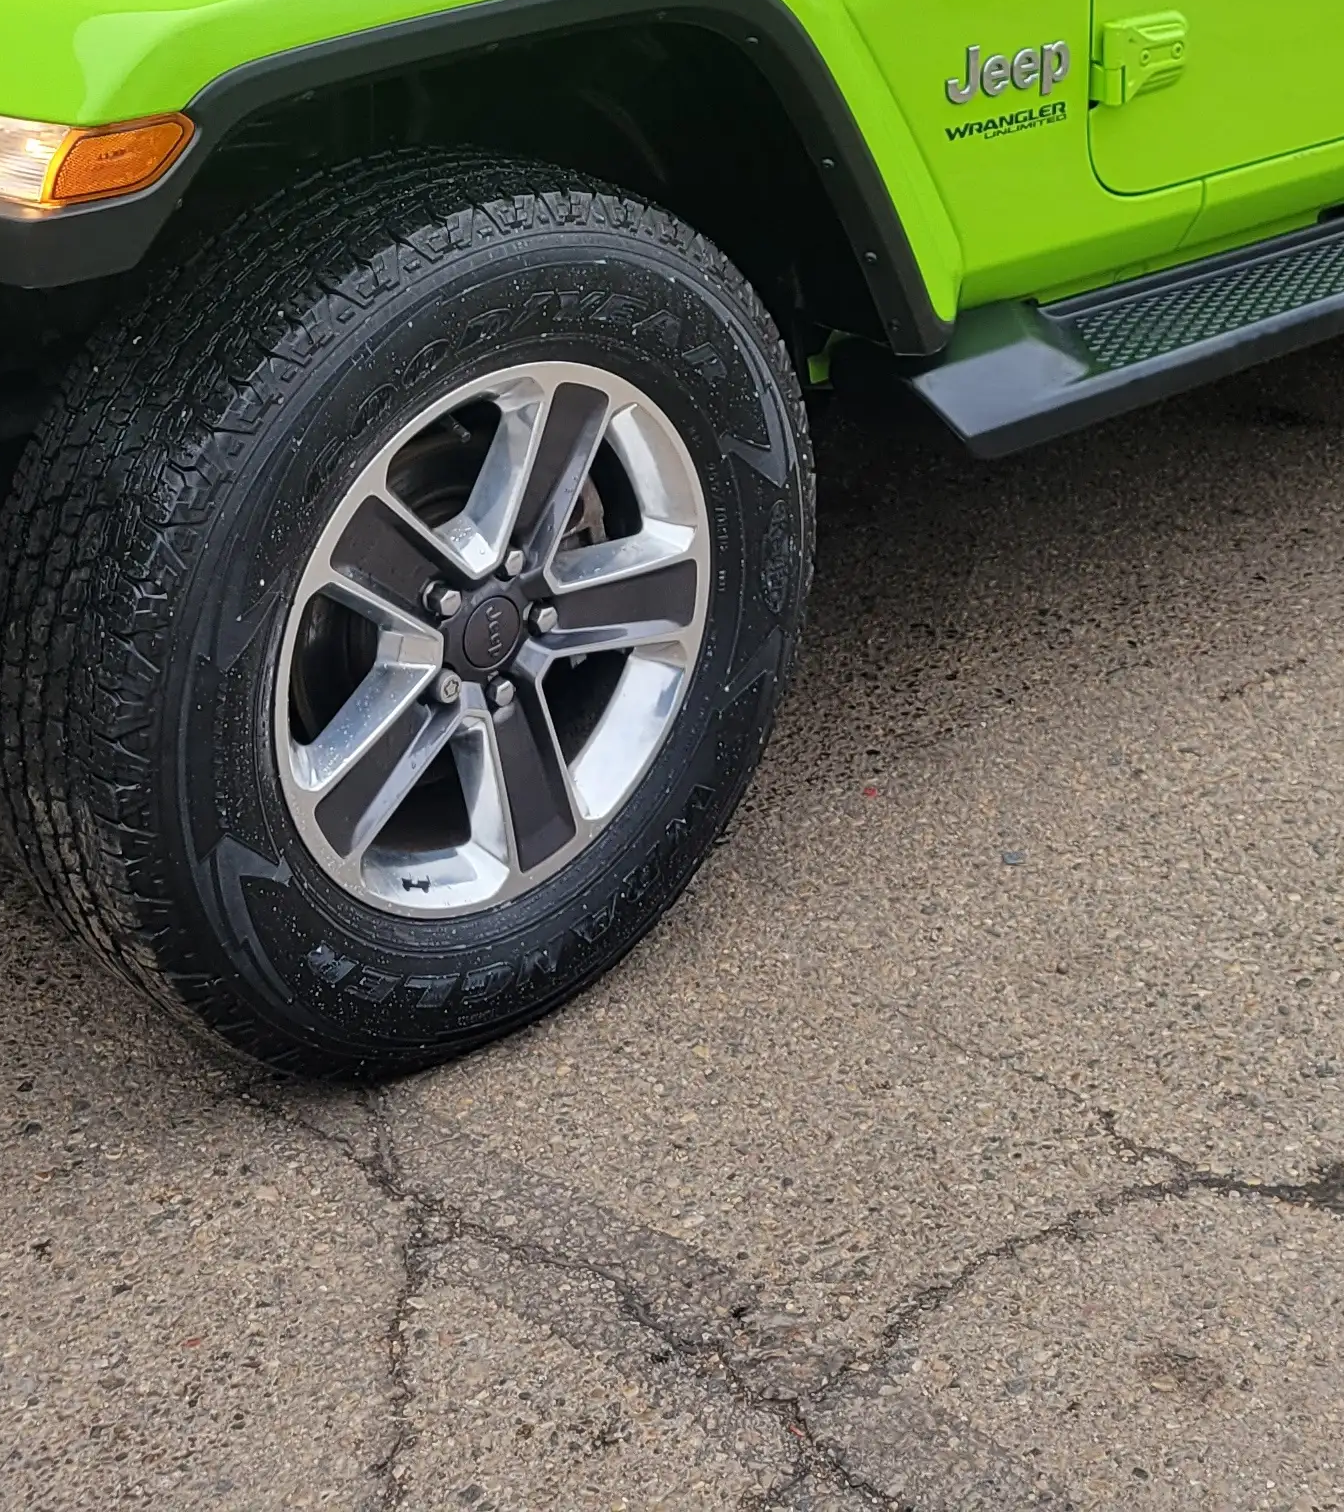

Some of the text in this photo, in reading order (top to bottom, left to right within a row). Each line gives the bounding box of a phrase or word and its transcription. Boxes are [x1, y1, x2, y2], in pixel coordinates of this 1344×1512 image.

[945, 39, 1071, 105] Jeep
[945, 100, 1067, 142] WRANGLER
[983, 112, 1068, 140] UNLIMITED
[485, 605, 504, 658] Jeep
